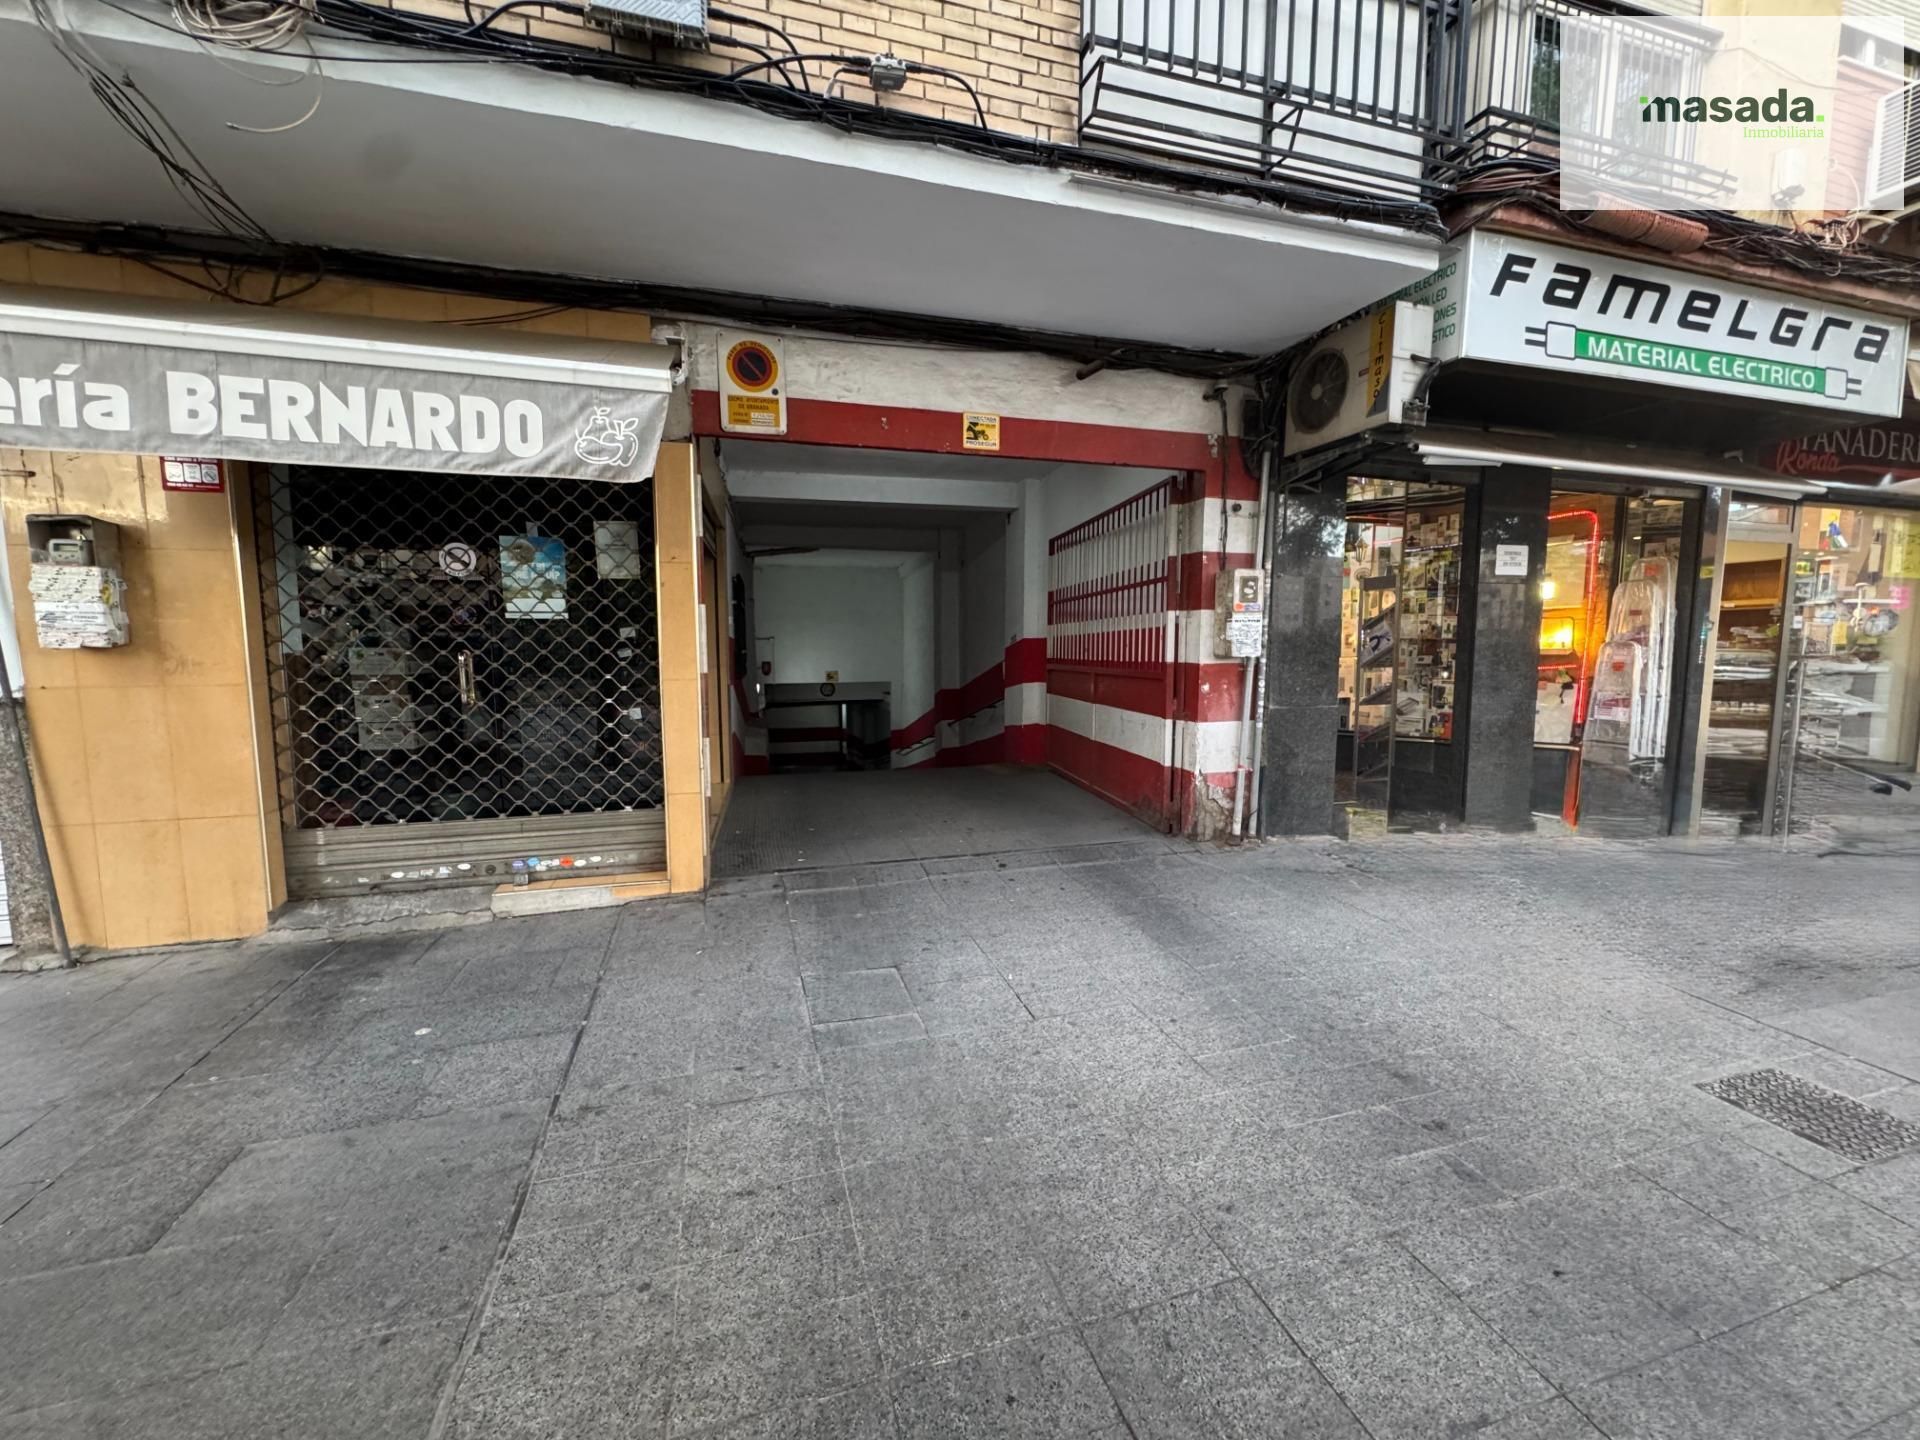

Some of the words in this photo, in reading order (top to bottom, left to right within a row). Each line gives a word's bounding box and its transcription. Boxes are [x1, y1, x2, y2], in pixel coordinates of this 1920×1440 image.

[1431, 287, 1447, 305] LED
[1588, 336, 1701, 373] MATERIAL
[166, 370, 544, 458] BERNARDO
